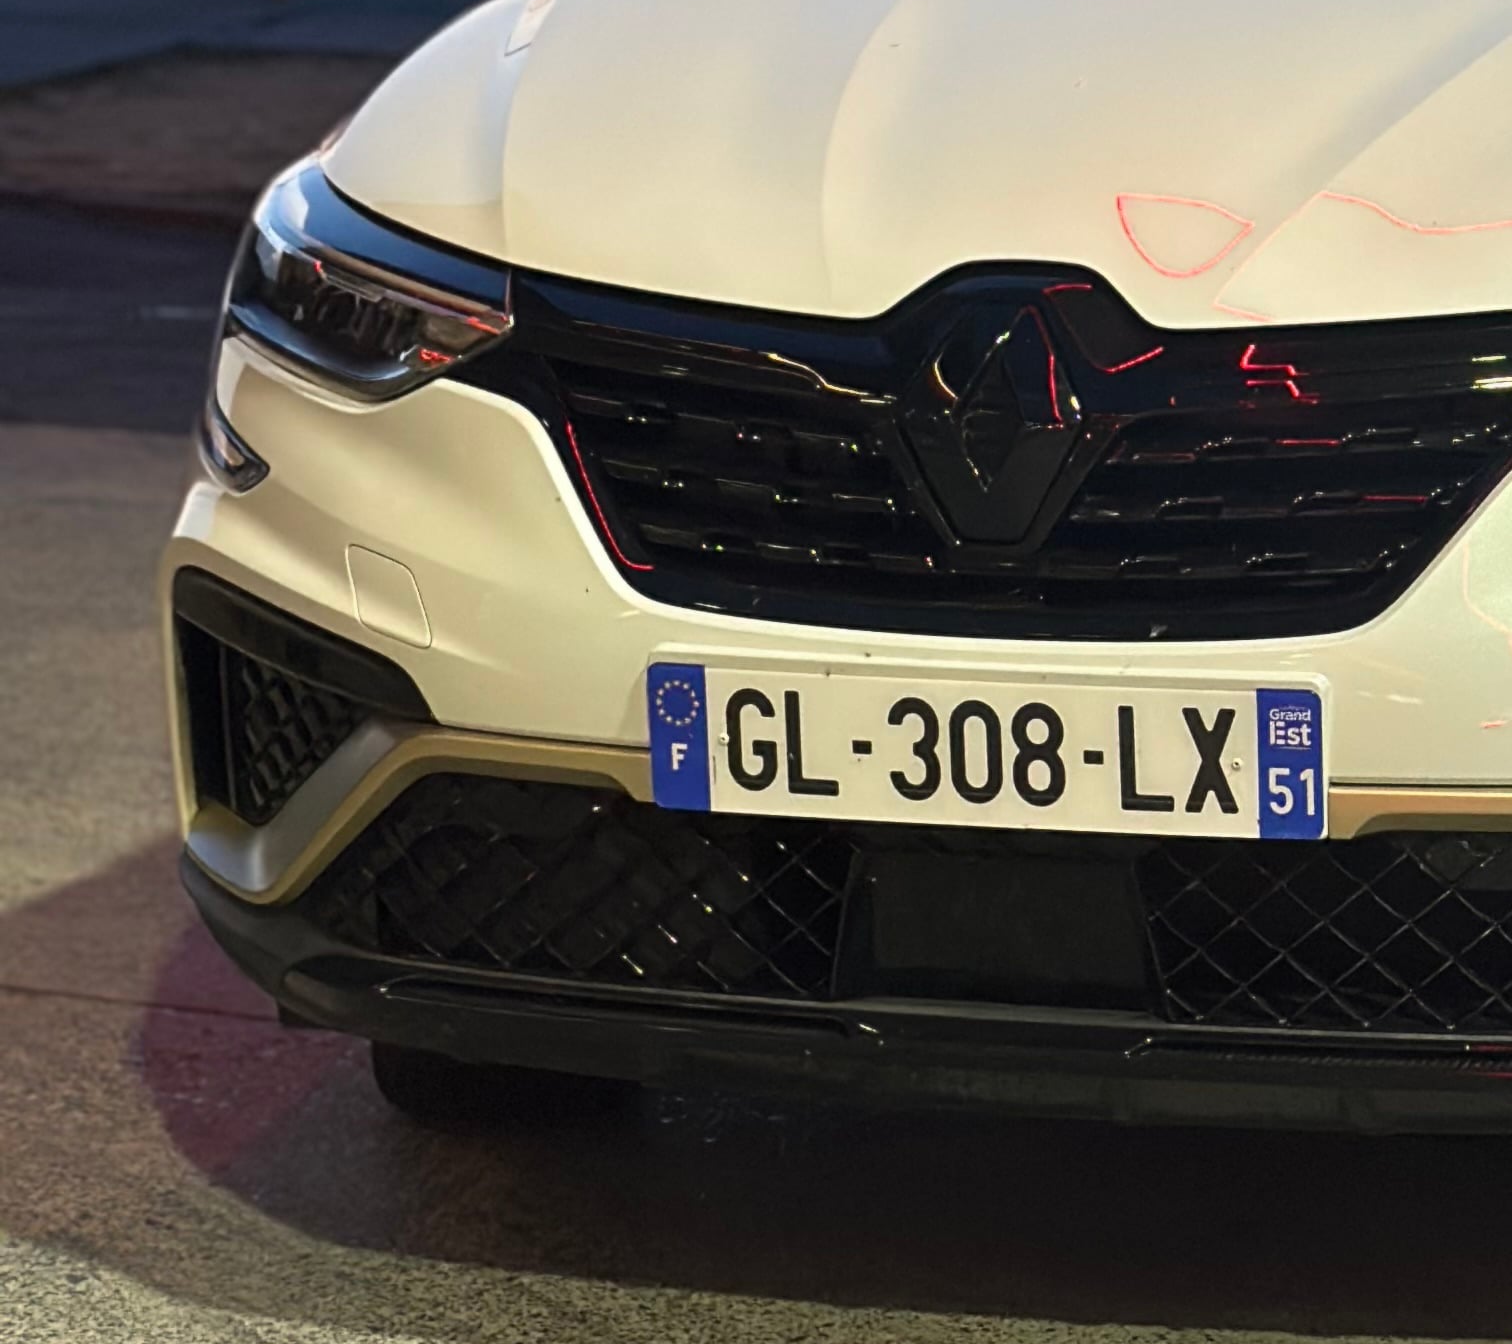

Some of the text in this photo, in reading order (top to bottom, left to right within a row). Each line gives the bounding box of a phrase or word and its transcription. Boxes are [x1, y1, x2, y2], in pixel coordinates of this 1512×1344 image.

[1269, 708, 1312, 722] Grand
[1269, 721, 1312, 746] Est
[669, 742, 688, 771] F
[725, 687, 1240, 815] GL-308-LX
[1268, 767, 1316, 816] 51
